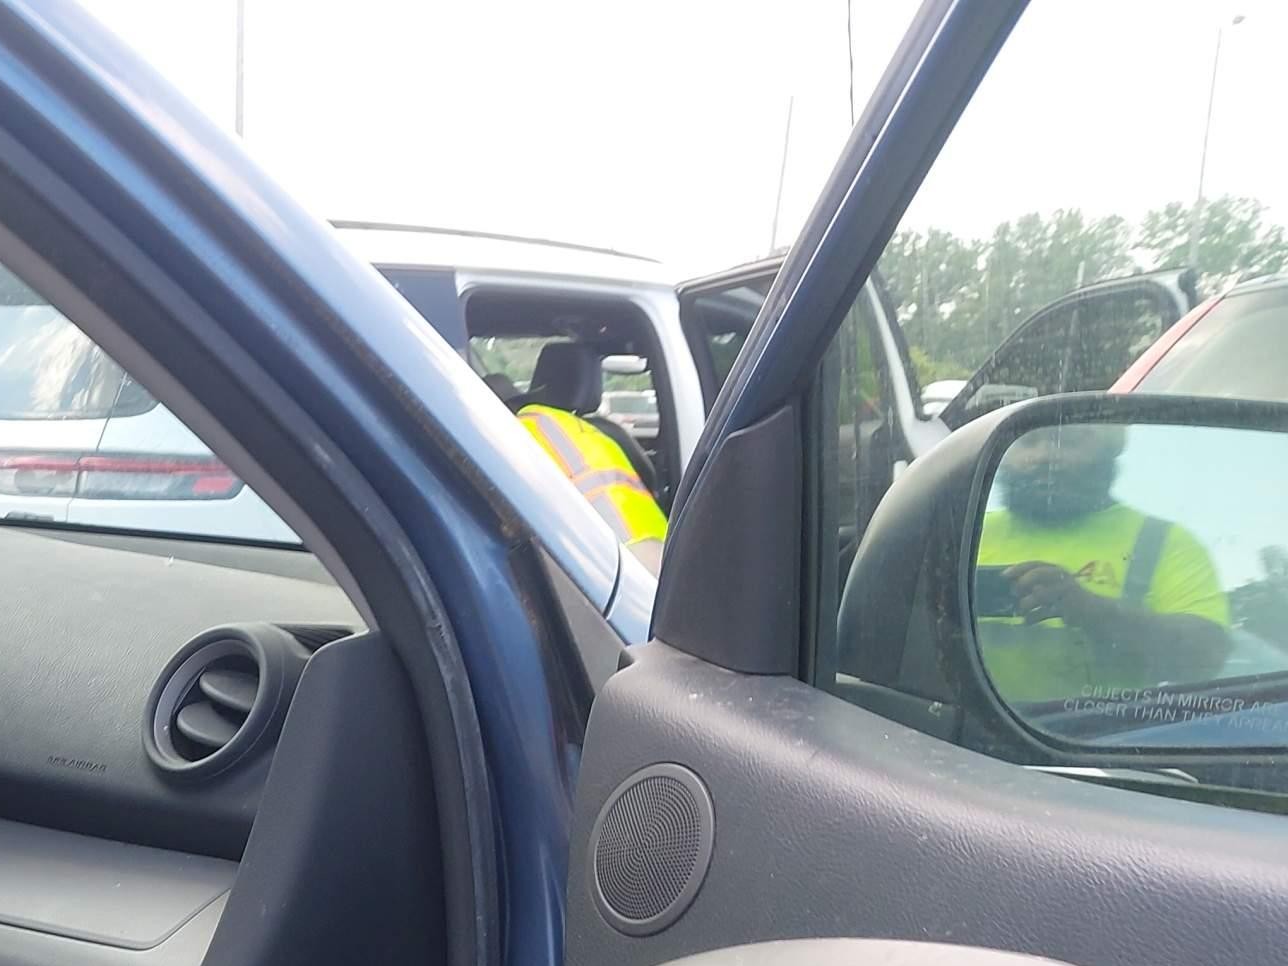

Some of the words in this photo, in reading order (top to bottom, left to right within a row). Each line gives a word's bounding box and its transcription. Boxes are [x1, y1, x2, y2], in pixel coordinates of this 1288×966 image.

[1063, 699, 1128, 719] CLOSER
[1134, 704, 1178, 722] THAN
[1081, 684, 1152, 703] OBJECTS
[1157, 690, 1176, 706] IN
[1178, 693, 1244, 713] MIRROR
